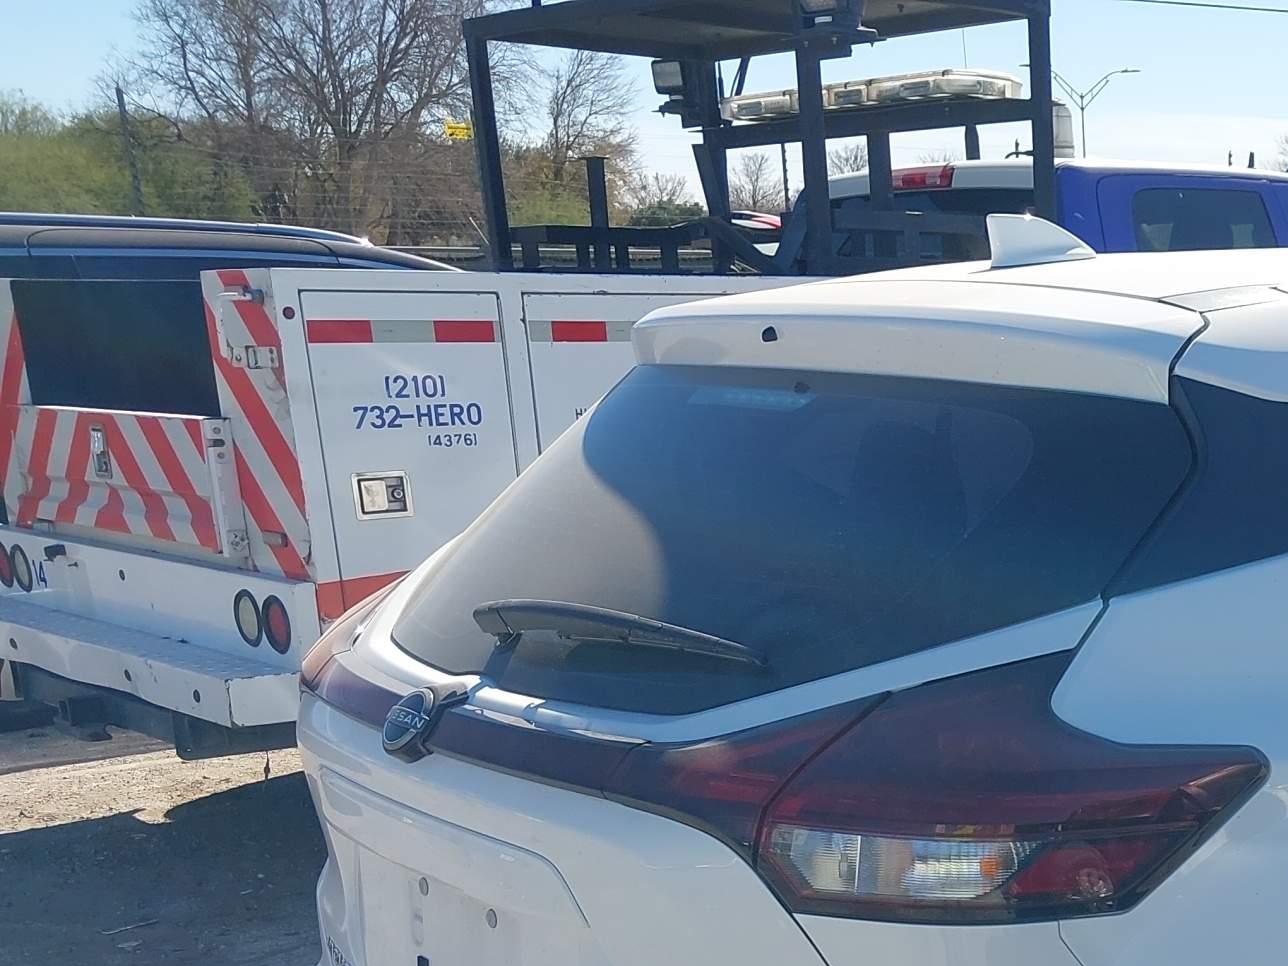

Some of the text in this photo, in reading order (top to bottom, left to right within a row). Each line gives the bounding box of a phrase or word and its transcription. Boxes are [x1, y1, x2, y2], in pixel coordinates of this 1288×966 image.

[384, 374, 446, 399] (210)
[352, 402, 483, 430] 732-HERO
[427, 432, 478, 447] (4376)
[388, 708, 425, 729] SSAN
